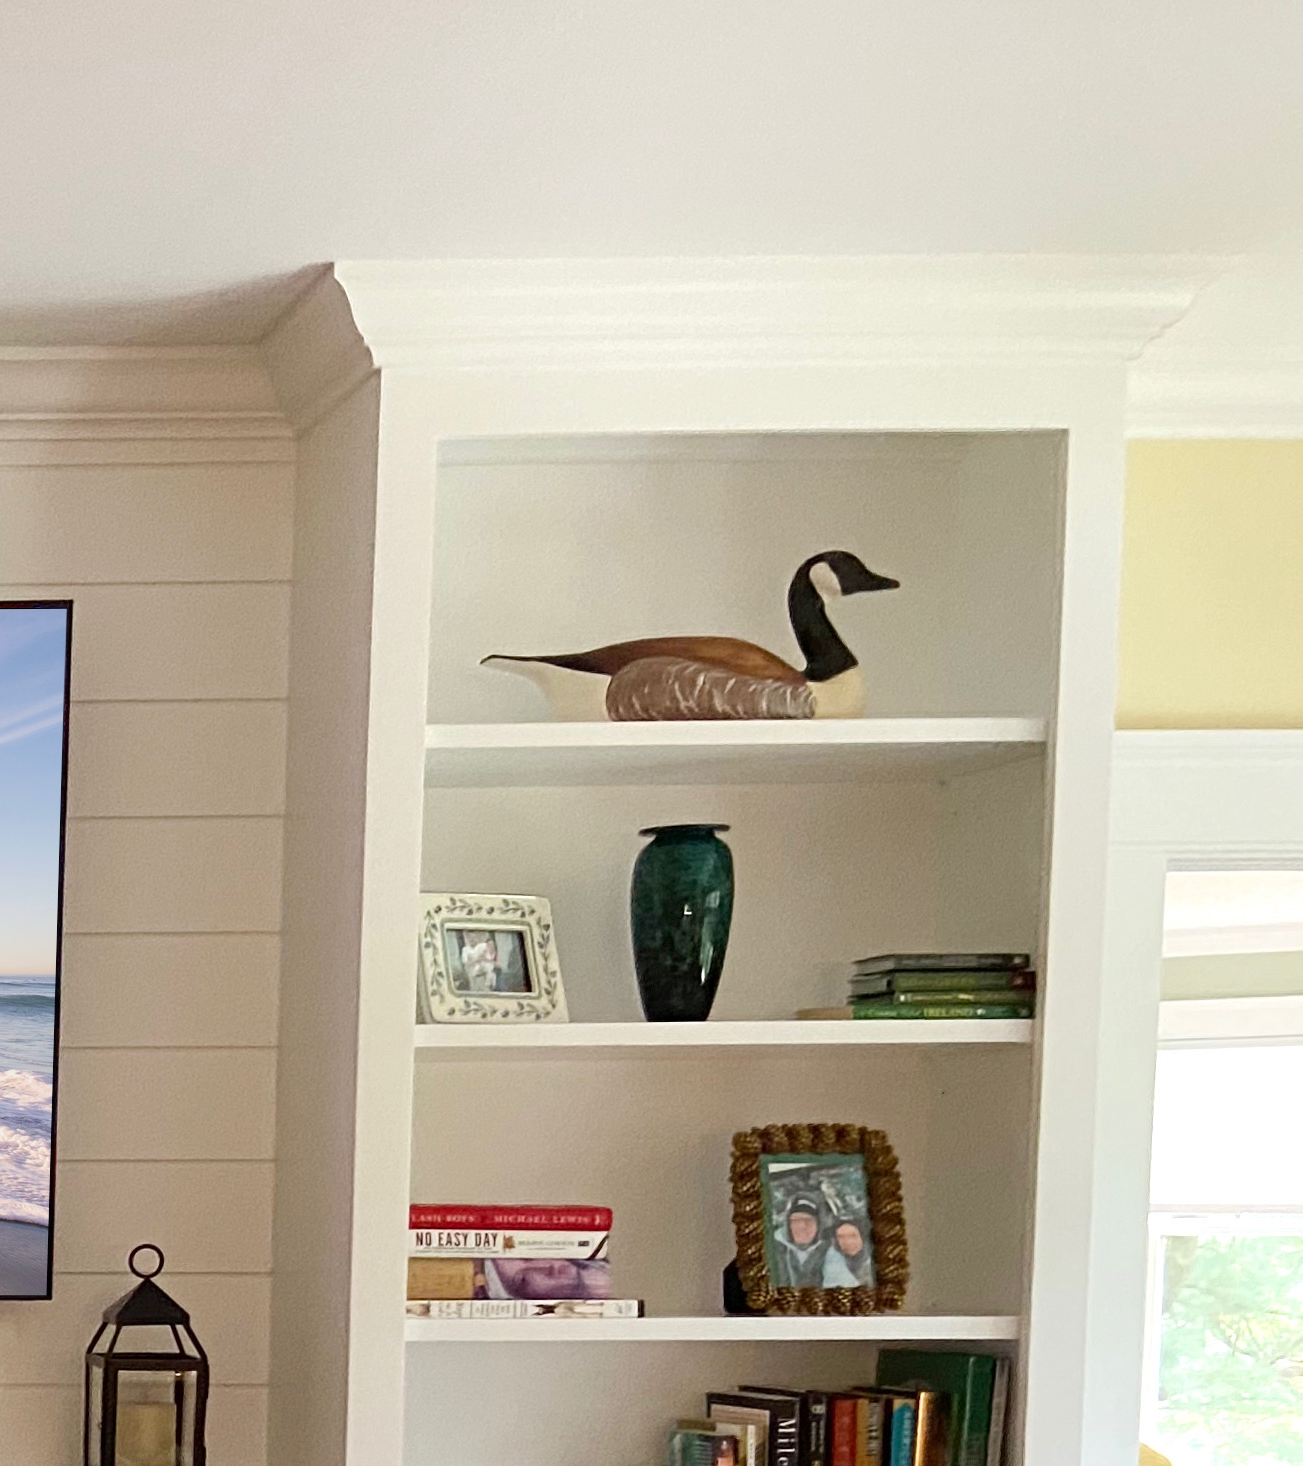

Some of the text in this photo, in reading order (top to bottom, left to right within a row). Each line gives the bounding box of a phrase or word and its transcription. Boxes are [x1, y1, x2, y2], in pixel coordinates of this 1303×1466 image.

[494, 1215, 589, 1224] MICHAEL LEWIS
[416, 1231, 498, 1247] NO EASY DAY
